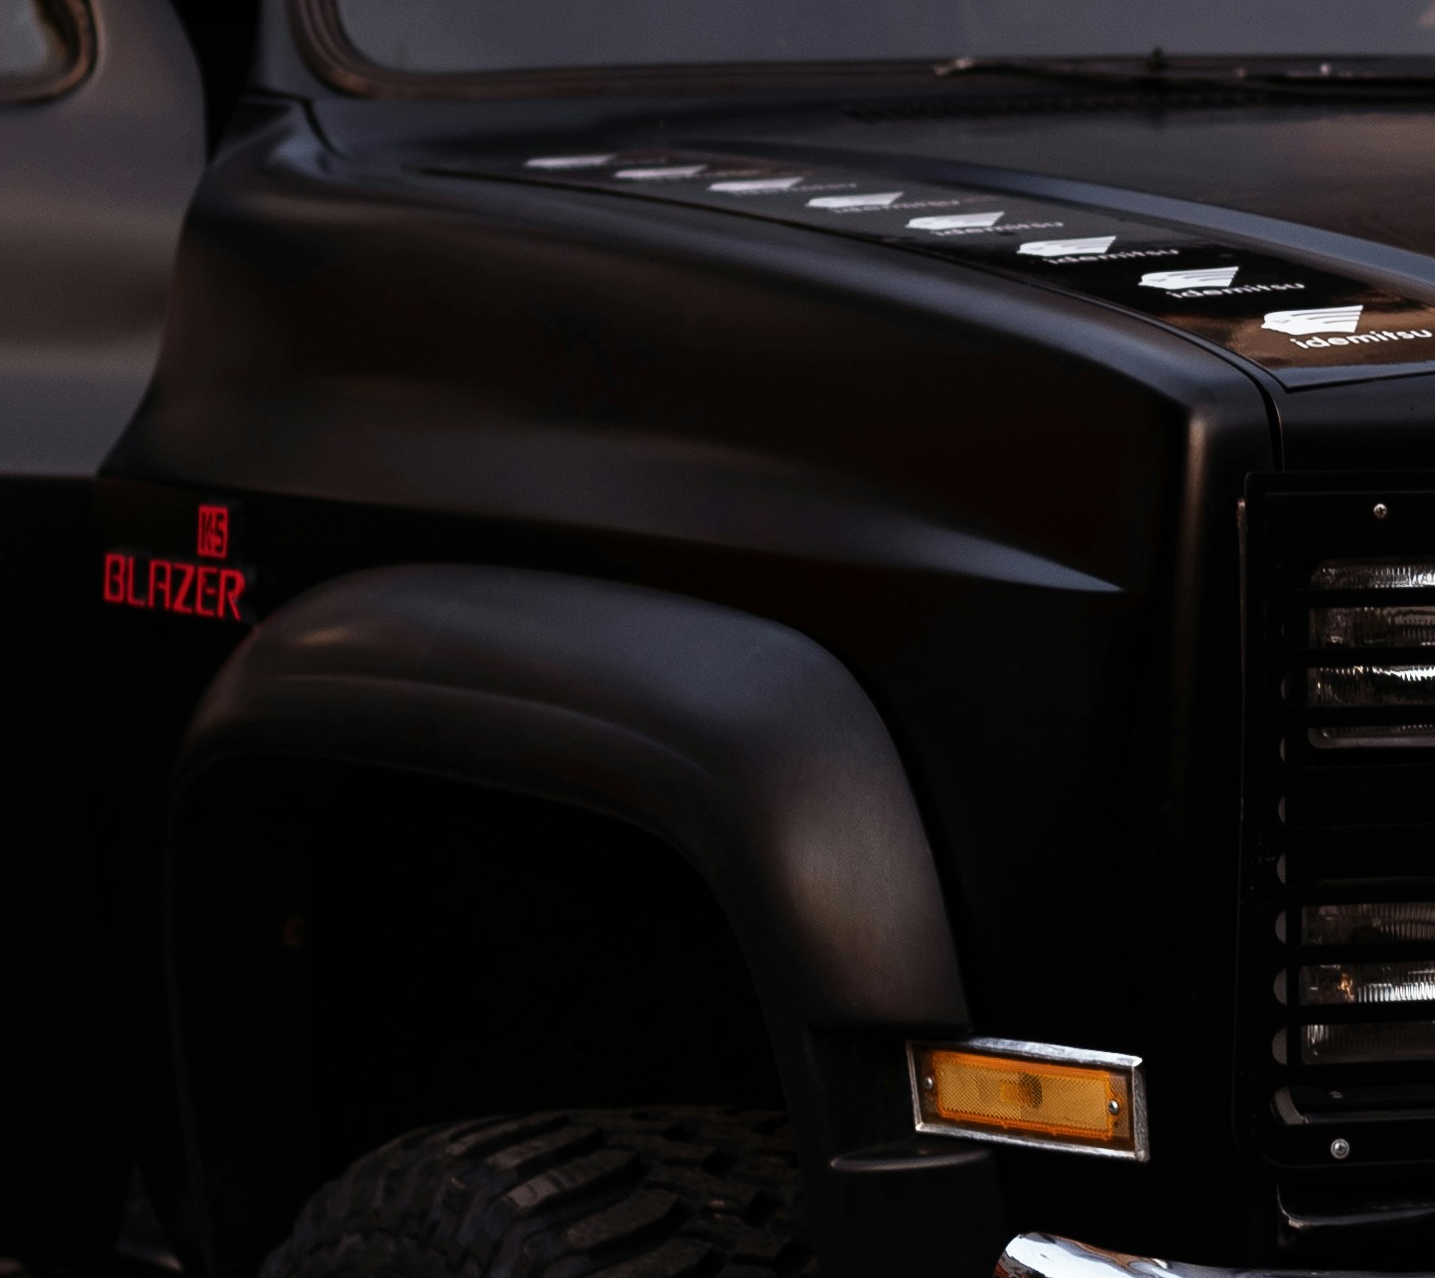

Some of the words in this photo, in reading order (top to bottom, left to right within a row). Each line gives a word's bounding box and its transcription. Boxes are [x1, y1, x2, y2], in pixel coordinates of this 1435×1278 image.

[1166, 282, 1305, 299] idemitsu
[1290, 329, 1433, 350] idemitsu
[103, 553, 246, 622] BLAZER
